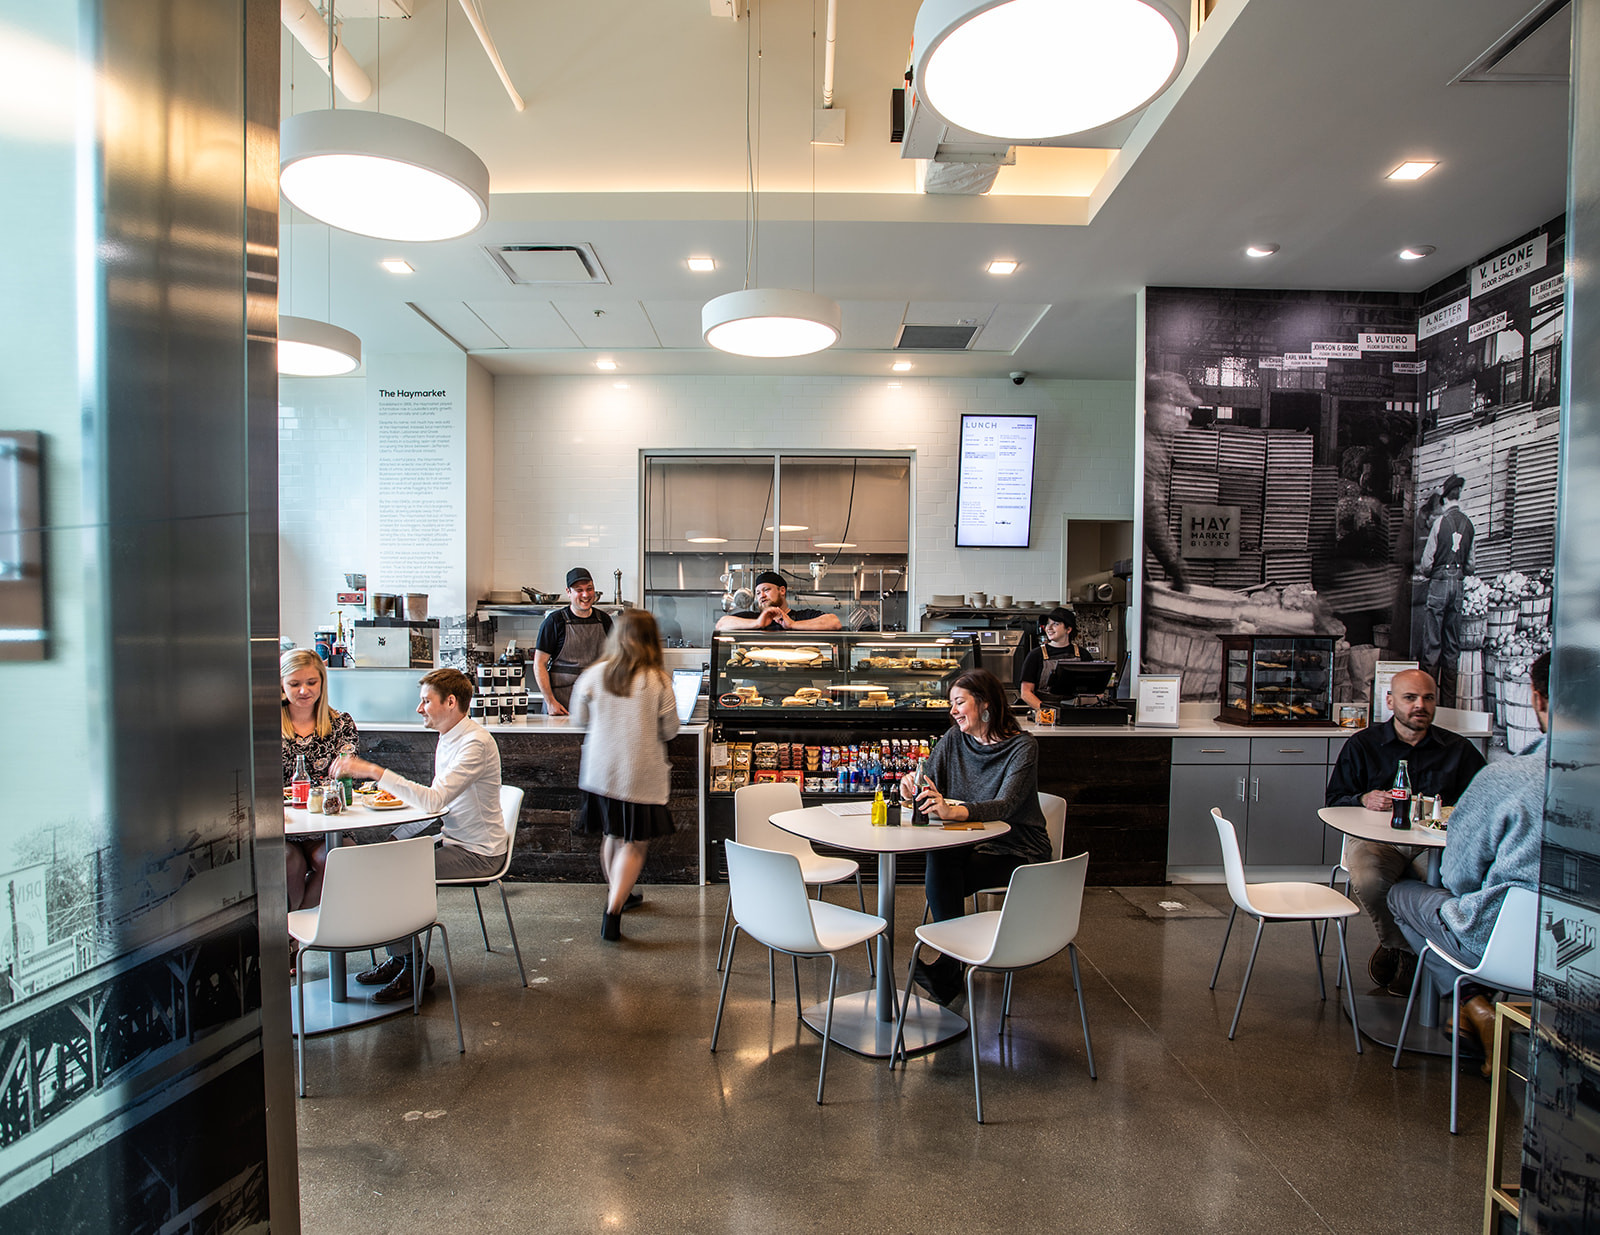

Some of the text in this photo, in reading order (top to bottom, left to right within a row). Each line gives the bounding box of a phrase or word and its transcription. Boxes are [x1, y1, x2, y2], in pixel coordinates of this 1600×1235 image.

[1480, 244, 1534, 279] V. LEONE
[1481, 276, 1498, 290] FLOOR
[1498, 269, 1514, 282] SPACE
[1524, 261, 1531, 270] 31
[1434, 304, 1462, 323] NETTER
[379, 390, 446, 399] The Haymarket
[1192, 517, 1230, 531] HAY
